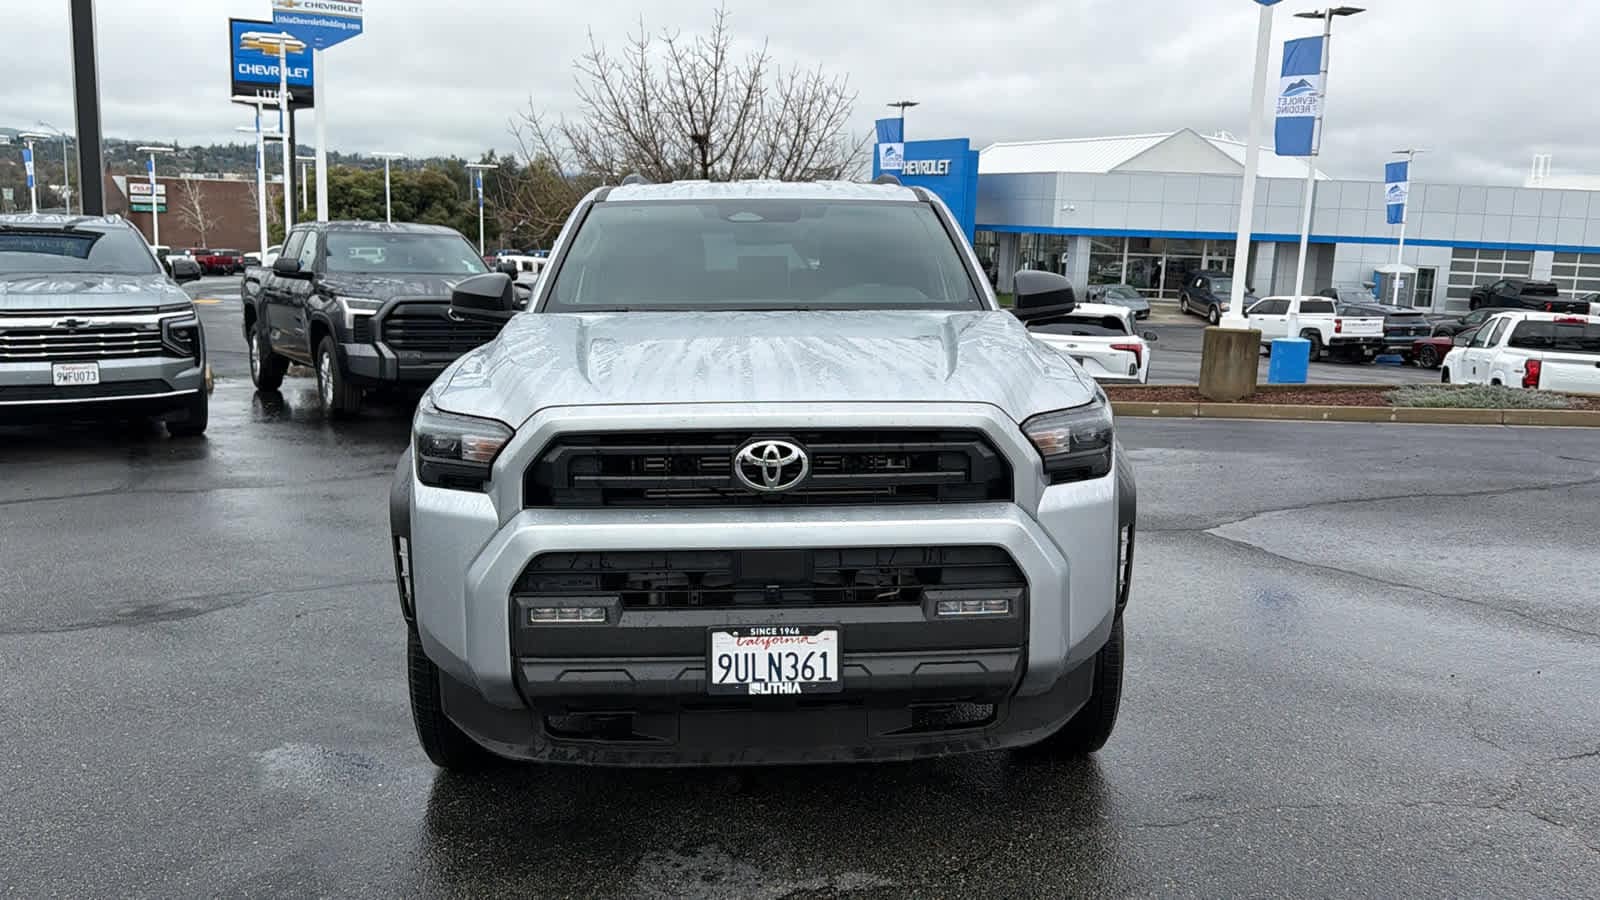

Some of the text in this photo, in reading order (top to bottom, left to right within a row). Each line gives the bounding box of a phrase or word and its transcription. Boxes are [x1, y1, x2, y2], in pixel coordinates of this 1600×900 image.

[304, 1, 359, 14] CHEVROLET
[238, 63, 310, 79] CHEVRLET
[901, 160, 951, 175] HEVROLET
[56, 371, 97, 383] 9WFU073
[780, 627, 800, 635] 1946
[736, 636, 818, 650] California
[718, 651, 832, 683] 9ULN361
[760, 682, 802, 694] LITHIA
